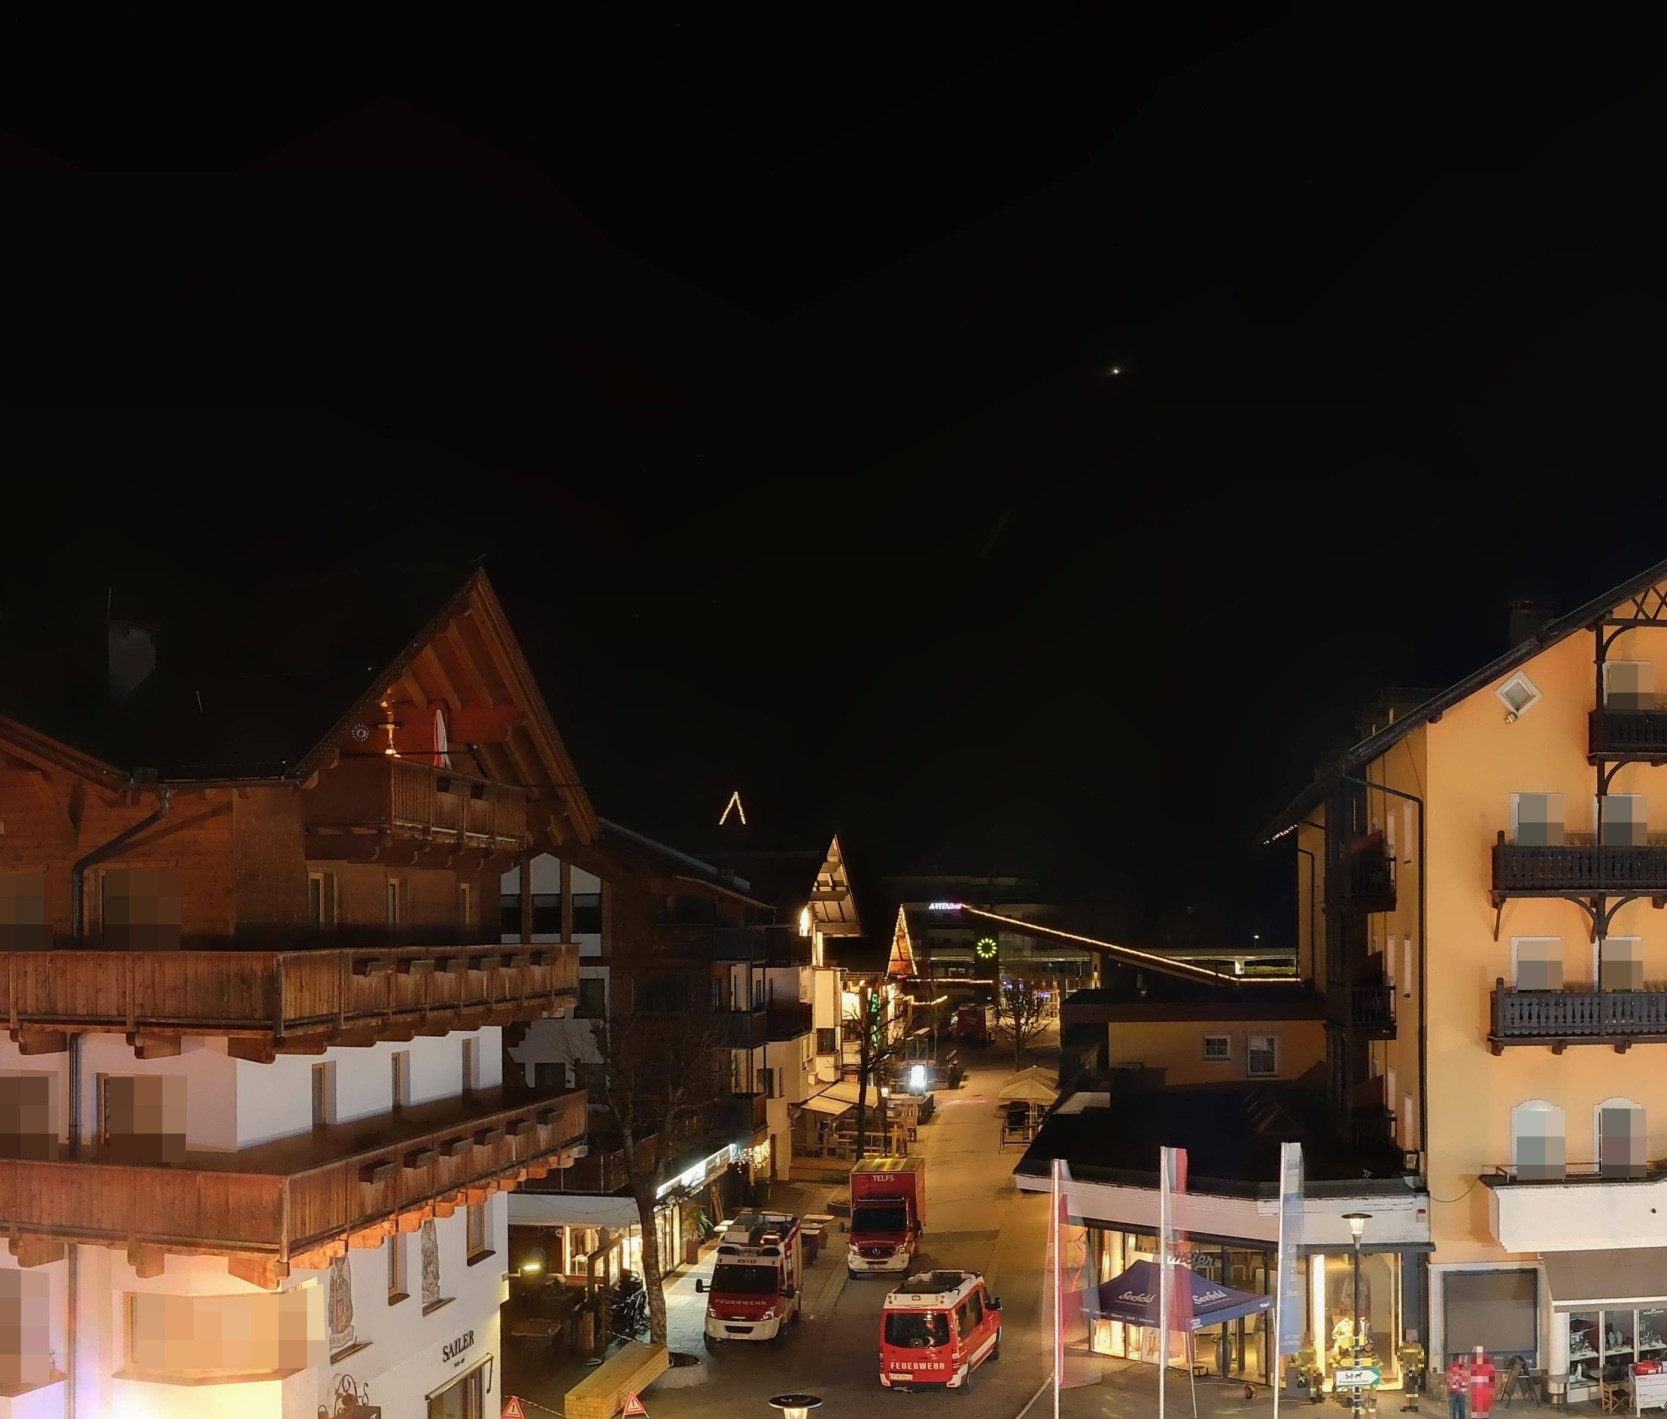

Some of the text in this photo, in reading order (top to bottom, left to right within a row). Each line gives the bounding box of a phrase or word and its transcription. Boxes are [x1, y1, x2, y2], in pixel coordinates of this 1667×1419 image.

[1118, 1290, 1157, 1304] Seefeld
[1192, 1290, 1227, 1305] Seefeld
[890, 1362, 945, 1370] FEUERWEHR
